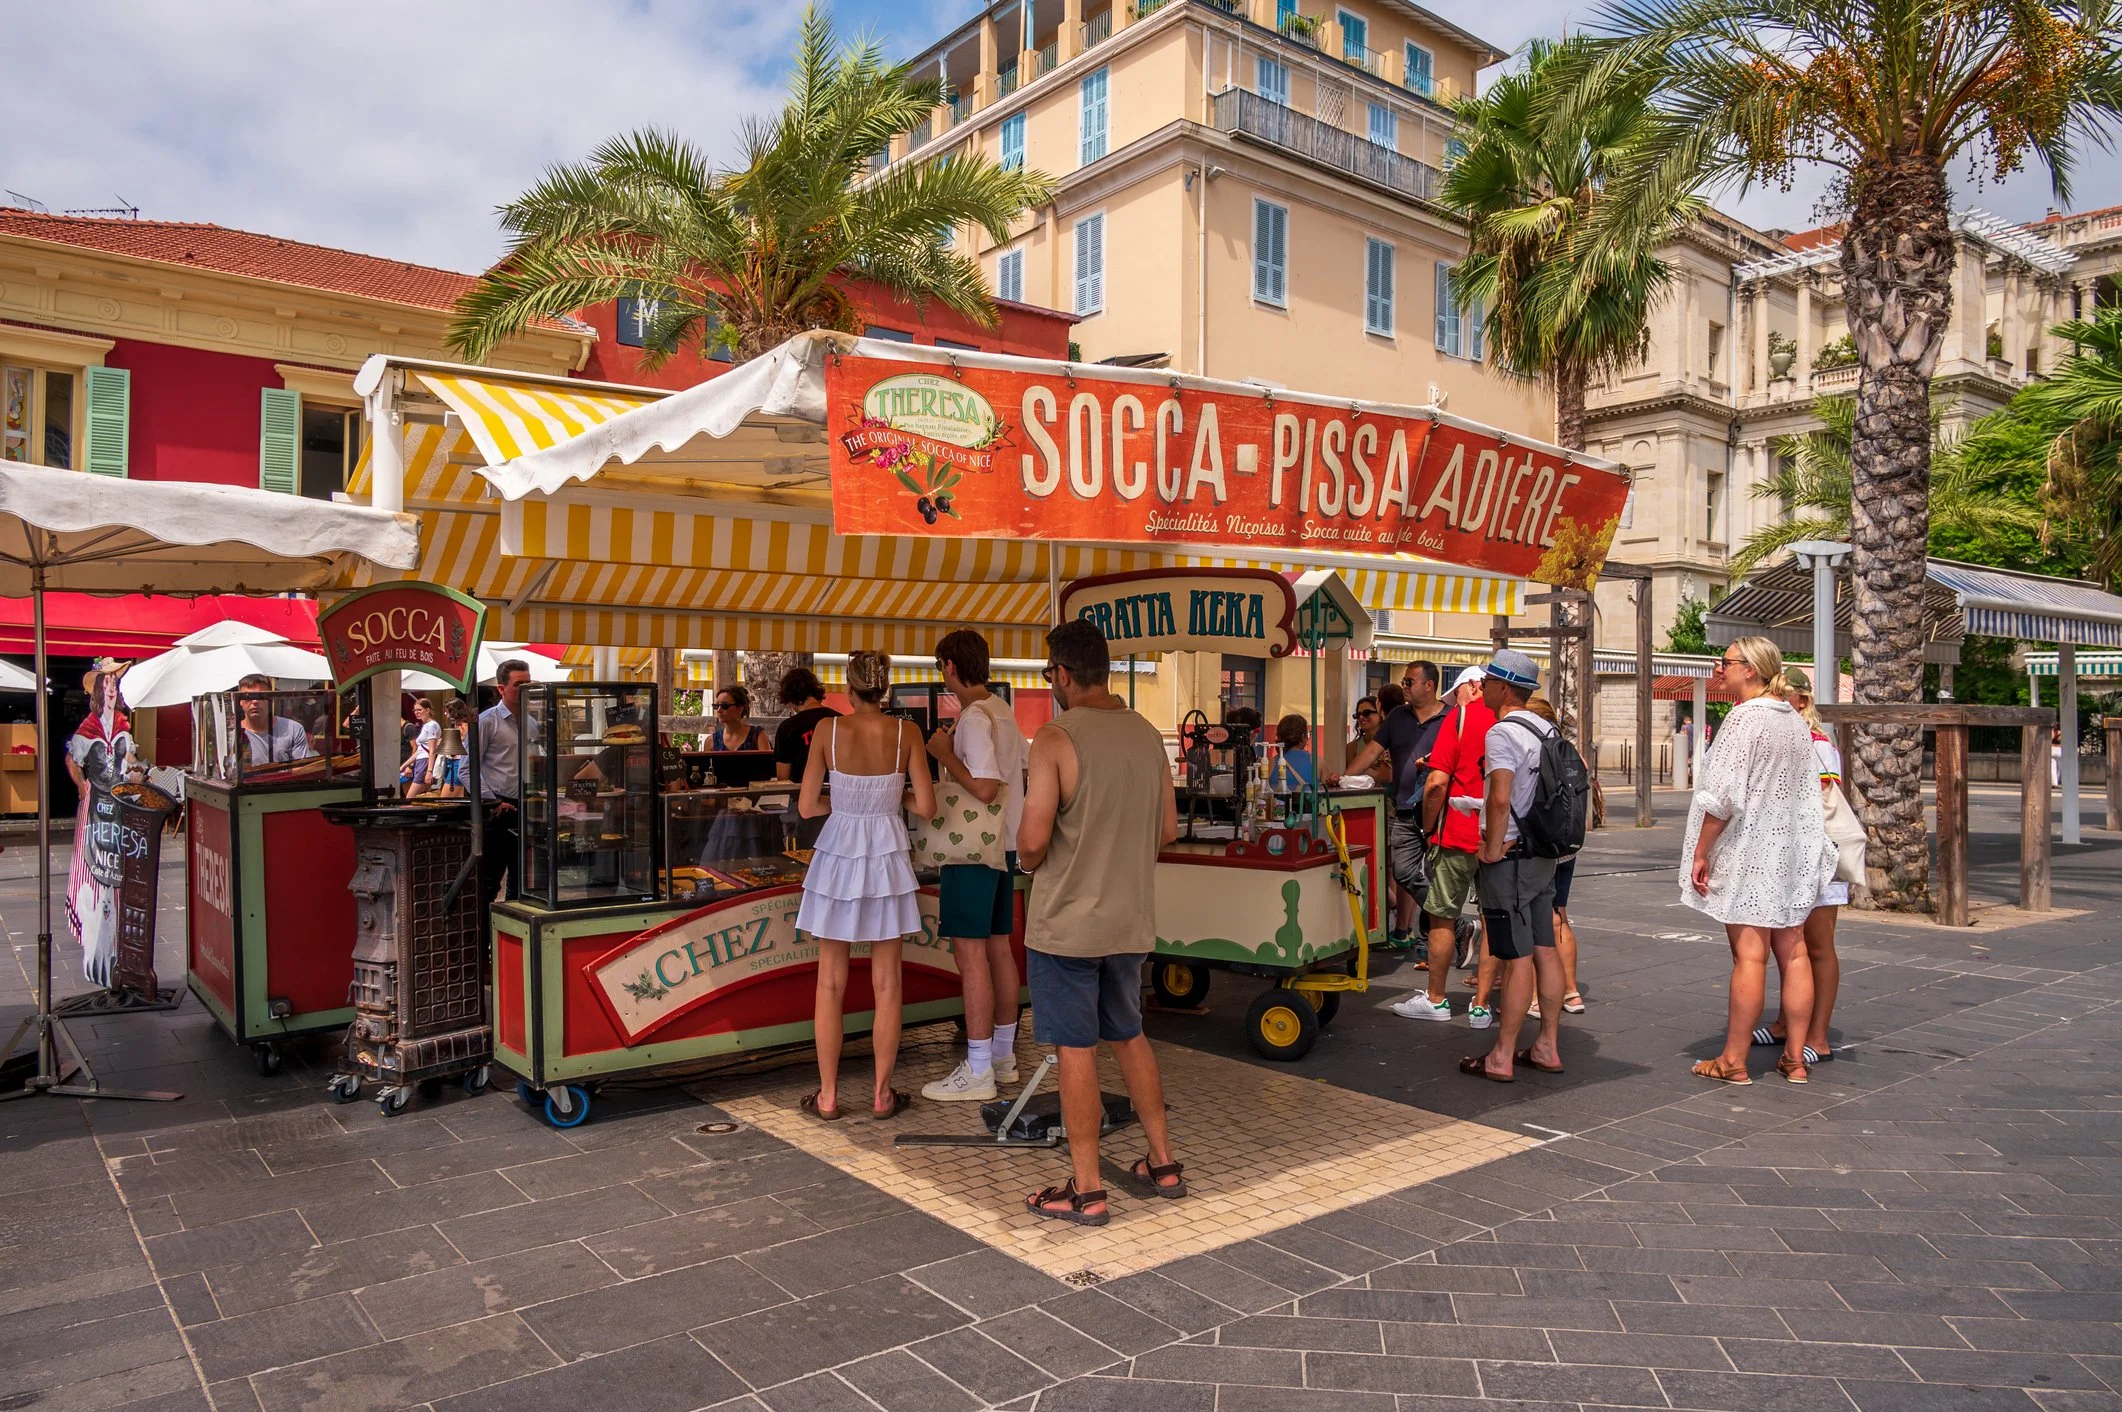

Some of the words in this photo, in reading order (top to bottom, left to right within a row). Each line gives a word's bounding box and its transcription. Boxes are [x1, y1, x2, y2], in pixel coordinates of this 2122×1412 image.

[918, 378, 939, 387] CHEZ
[874, 387, 980, 426] THERESA
[845, 433, 867, 452] THE
[869, 431, 916, 447] ORIGINAL
[921, 441, 955, 461] SOCCA
[956, 452, 967, 464] OF
[969, 454, 991, 468] NICE
[1021, 384, 1228, 503] SOCCA
[1145, 509, 1219, 535] Spécialités
[1226, 514, 1286, 539] Niçoises
[1300, 519, 1339, 540] Socca
[1343, 523, 1372, 542] cuite
[1378, 532, 1394, 544] au
[1417, 529, 1445, 551] bois
[347, 607, 446, 656] SOCCA
[1188, 589, 1265, 639] KEKA
[366, 651, 381, 666] FAITE
[384, 649, 393, 660] AU
[395, 648, 407, 659] FEU
[409, 649, 417, 660] DE
[420, 652, 434, 663] BOIS
[96, 802, 113, 815] CHEZ
[84, 821, 148, 859] THERESA
[96, 849, 120, 869] NICE
[104, 868, 124, 881] d'Azur
[195, 841, 231, 919] THERESA
[655, 916, 775, 988] CHEZ
[750, 948, 820, 971] SPECIALITIE
[851, 943, 870, 954] NIC
